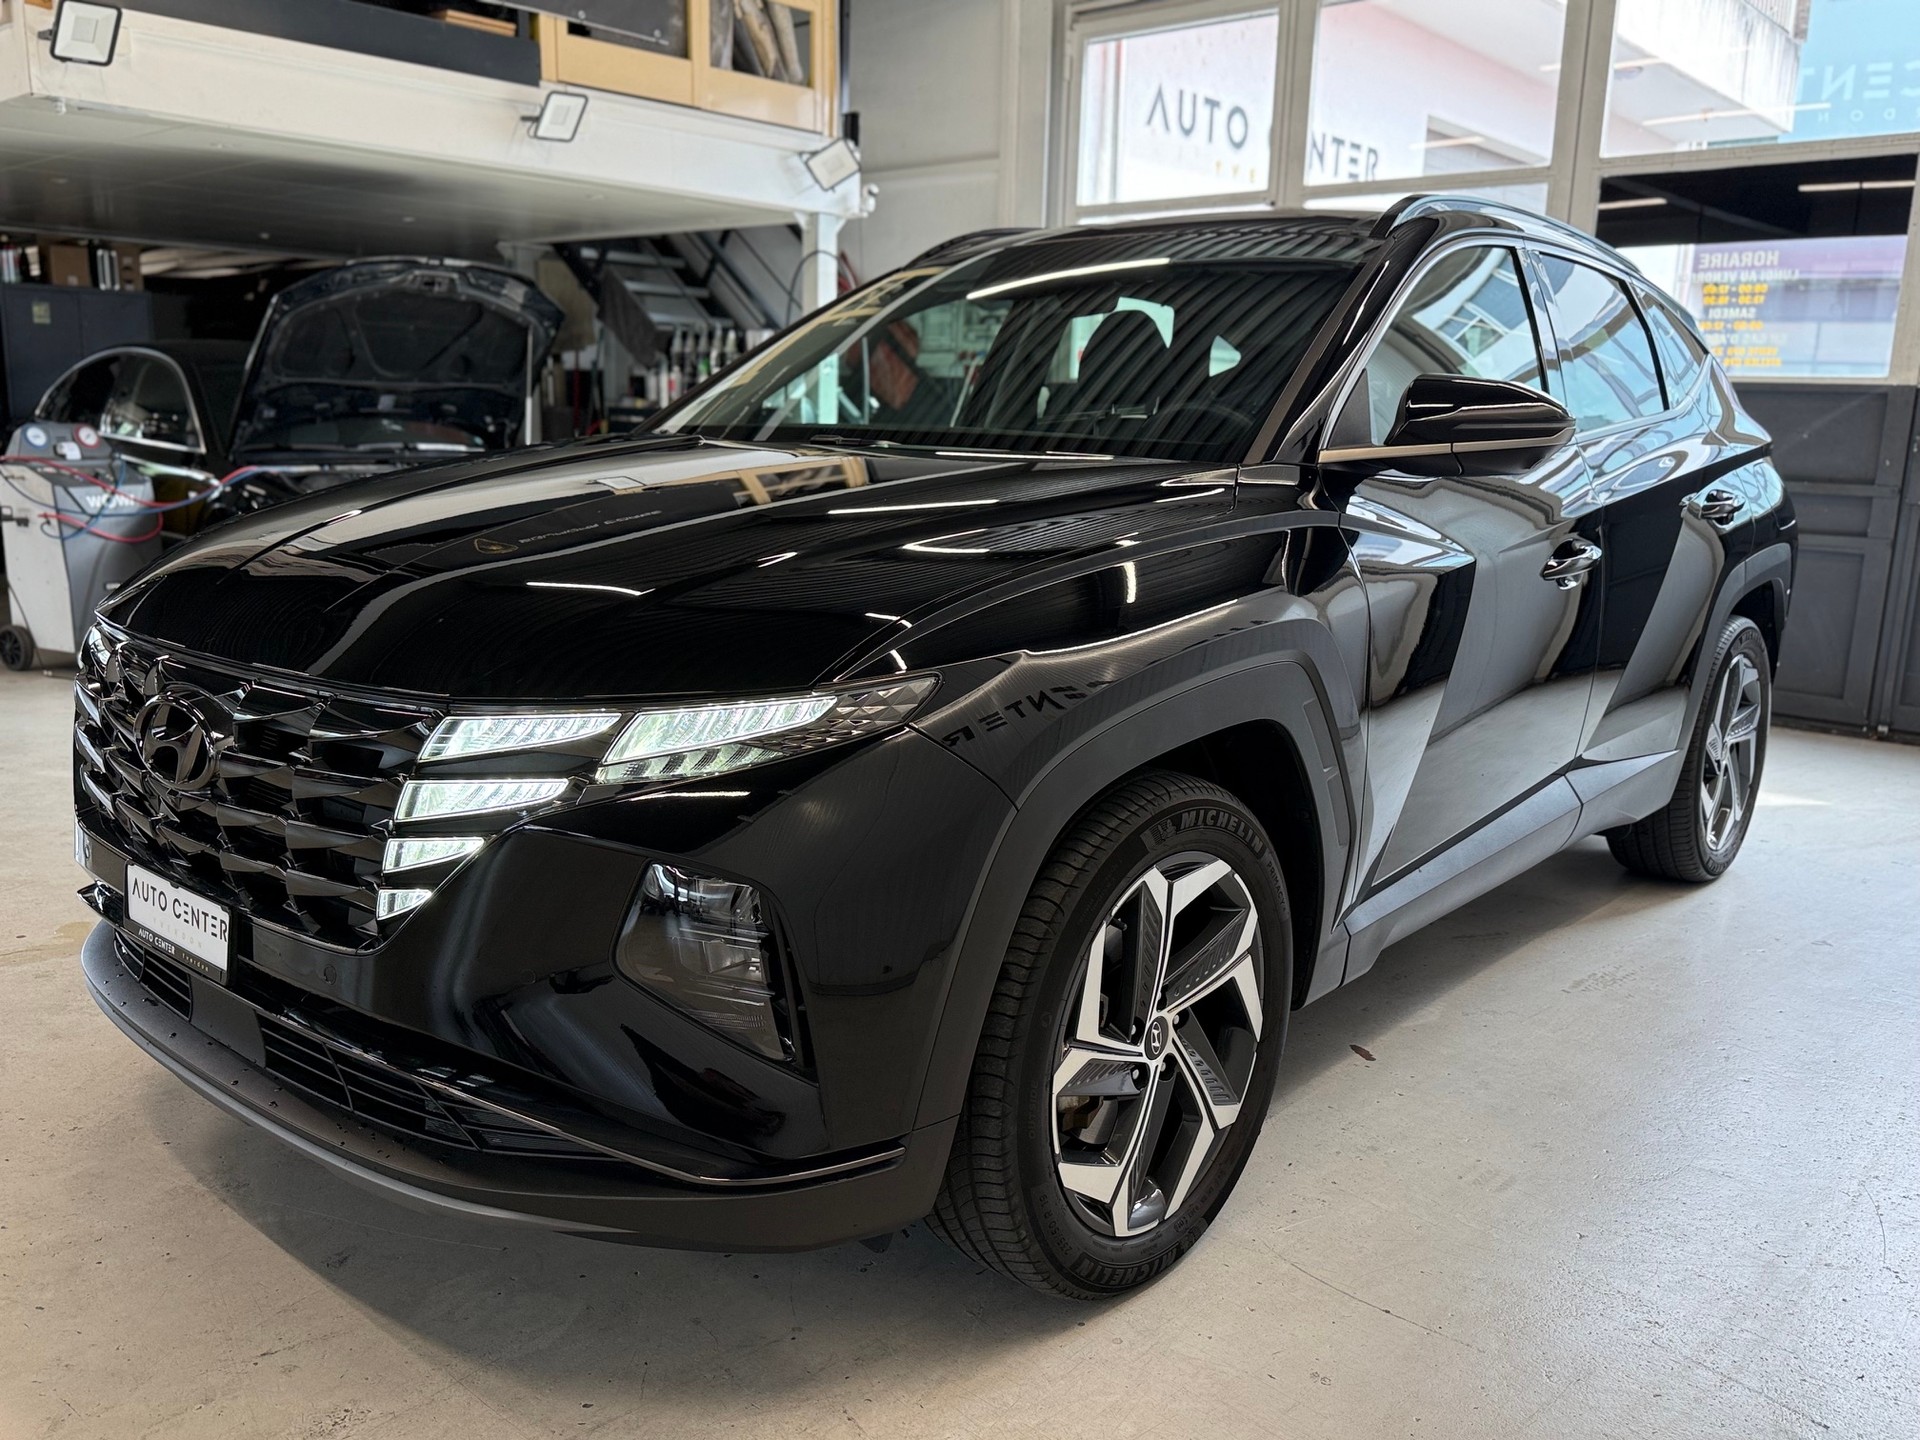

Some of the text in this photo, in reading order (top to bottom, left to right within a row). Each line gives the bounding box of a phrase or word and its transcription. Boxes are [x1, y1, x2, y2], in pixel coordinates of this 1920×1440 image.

[1146, 84, 1379, 182] AUTO NTER
[1180, 808, 1264, 854] MICHELIN
[1266, 860, 1287, 906] PRIMACY
[132, 877, 228, 943] AUTO CENTER
[138, 928, 154, 943] AUTO
[154, 936, 176, 956] CENTER
[1075, 1246, 1177, 1286] MICHELIN
